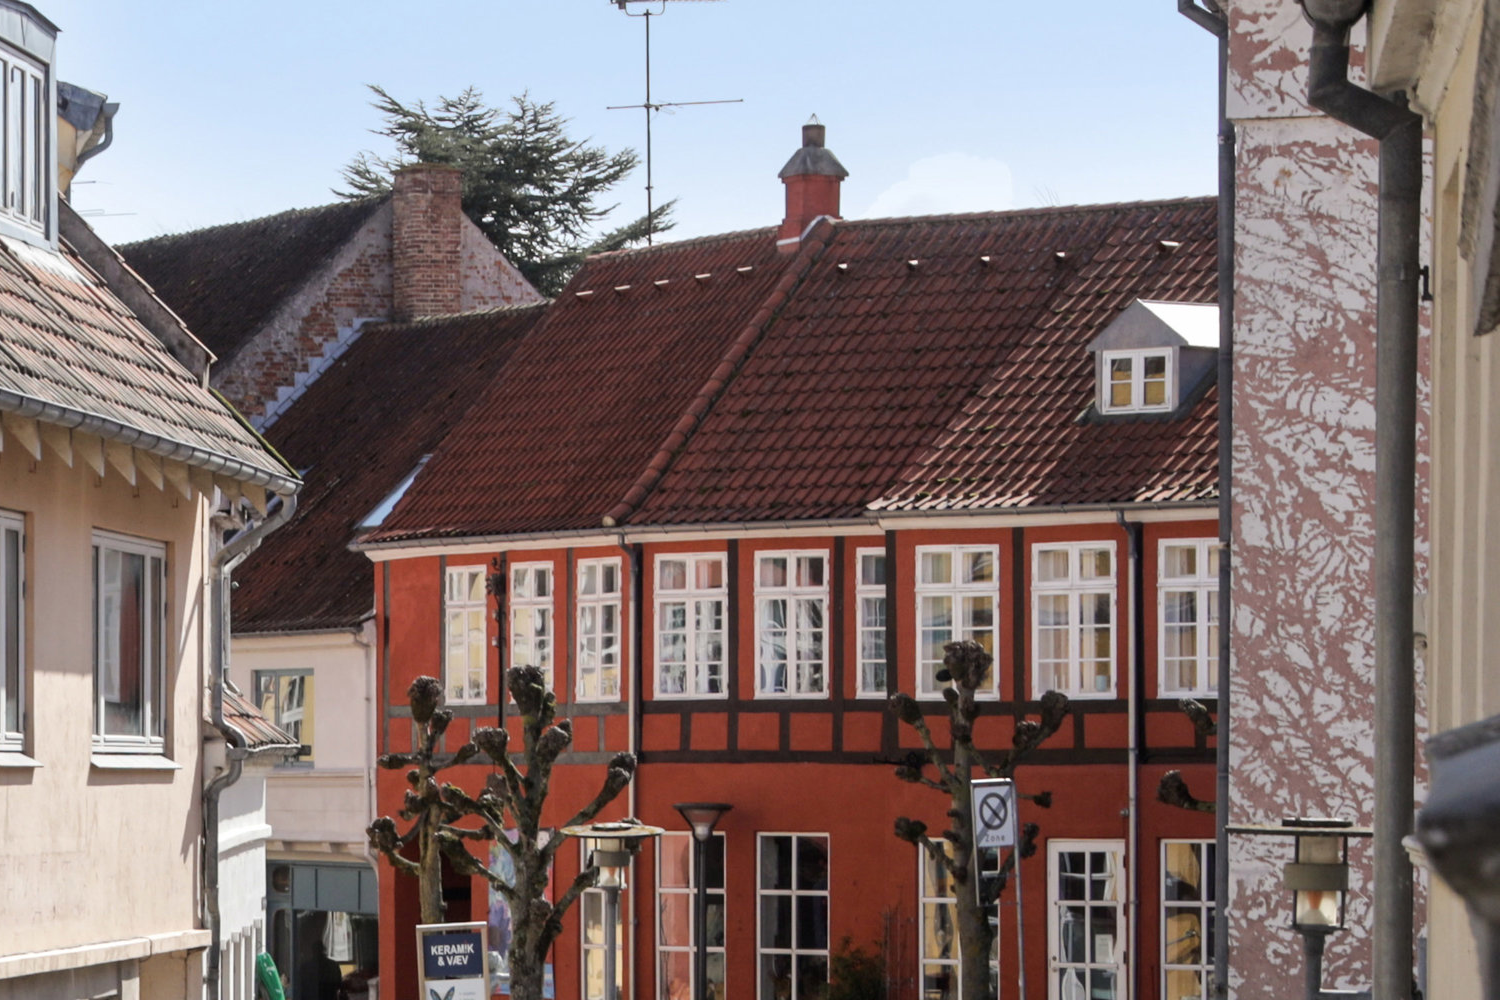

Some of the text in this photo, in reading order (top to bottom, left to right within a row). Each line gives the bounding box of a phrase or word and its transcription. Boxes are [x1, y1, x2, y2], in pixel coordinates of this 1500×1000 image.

[985, 834, 1005, 842] Zone
[437, 955, 469, 967] & VÆV
